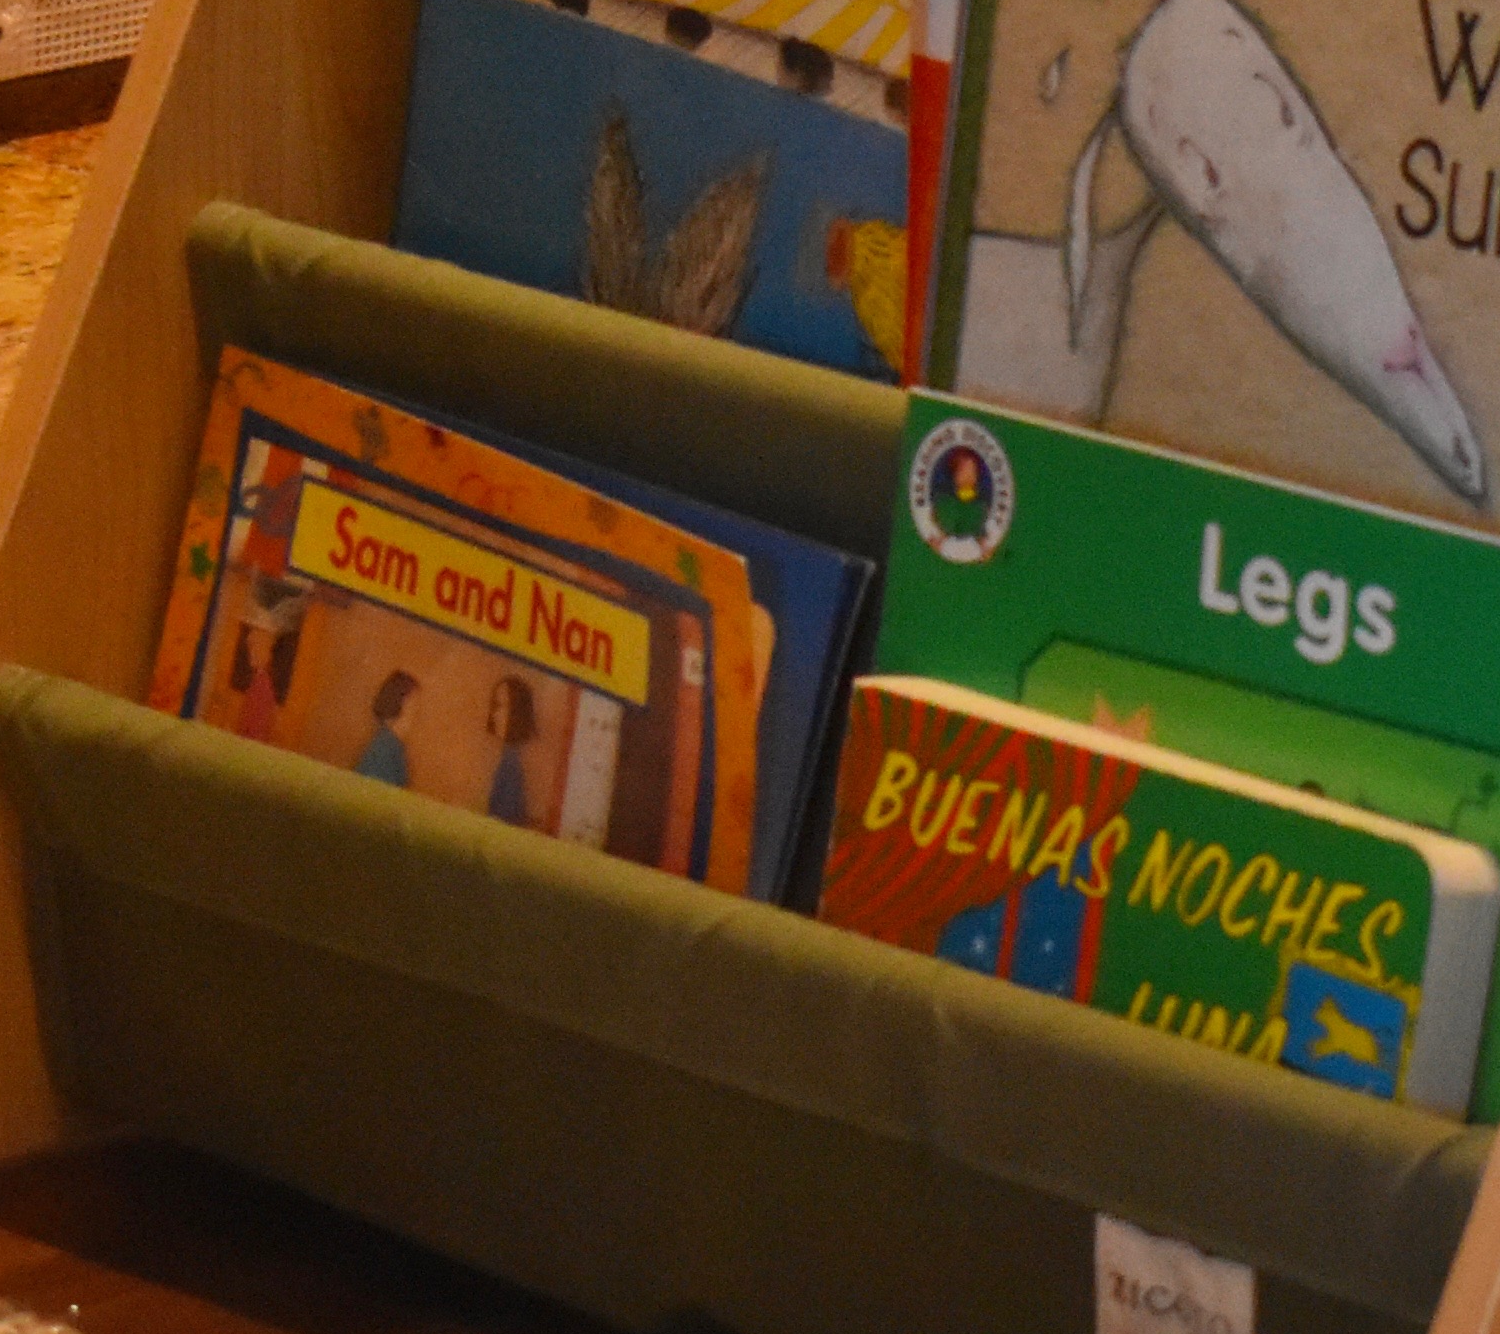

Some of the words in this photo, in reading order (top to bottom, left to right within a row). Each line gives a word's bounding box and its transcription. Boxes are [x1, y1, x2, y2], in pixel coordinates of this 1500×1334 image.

[326, 506, 419, 597] Sam
[433, 568, 516, 633] and
[527, 578, 614, 679] Nan
[1198, 521, 1398, 665] Legs
[861, 750, 1130, 900] BUENAS
[1126, 826, 1406, 987] NOCHES
